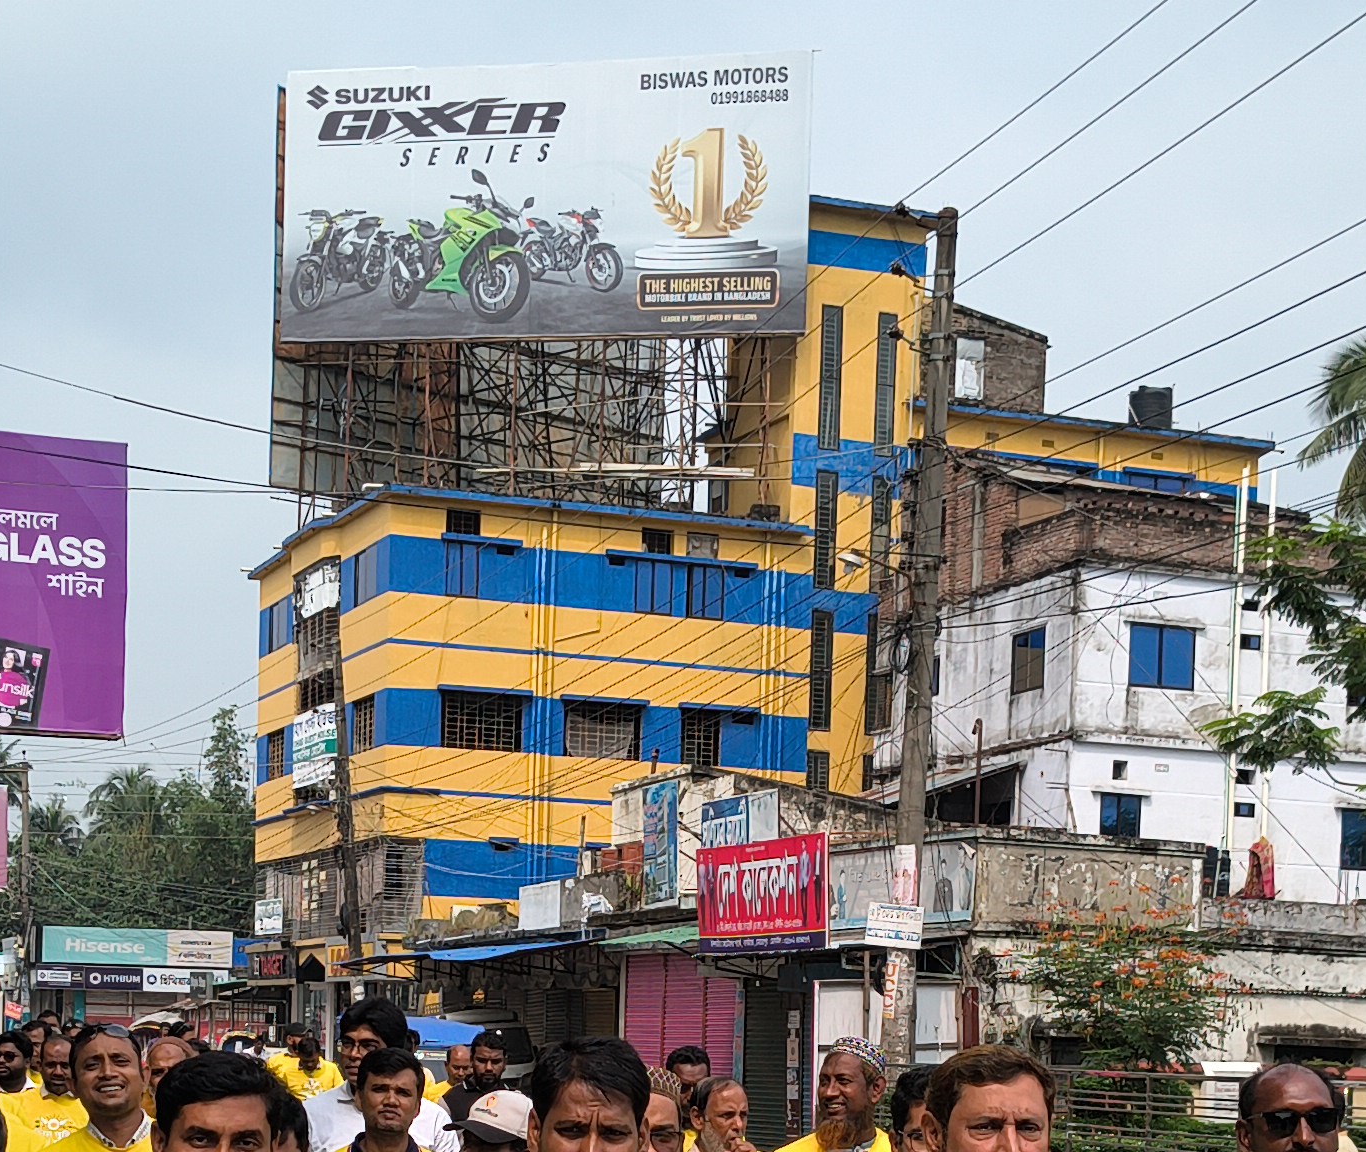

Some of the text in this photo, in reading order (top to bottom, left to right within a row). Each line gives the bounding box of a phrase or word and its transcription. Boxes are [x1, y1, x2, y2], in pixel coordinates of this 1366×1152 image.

[639, 66, 790, 91] BISWAS MOTORS
[334, 84, 432, 105] SUZUKI
[710, 88, 790, 105] 01991868488
[317, 97, 567, 145] GIXXER
[400, 143, 551, 167] SERIES
[644, 276, 772, 293] THE HIGHEST SELLING
[713, 291, 723, 301] IN
[46, 571, 105, 600] শাইন
[64, 937, 146, 954] Hisense
